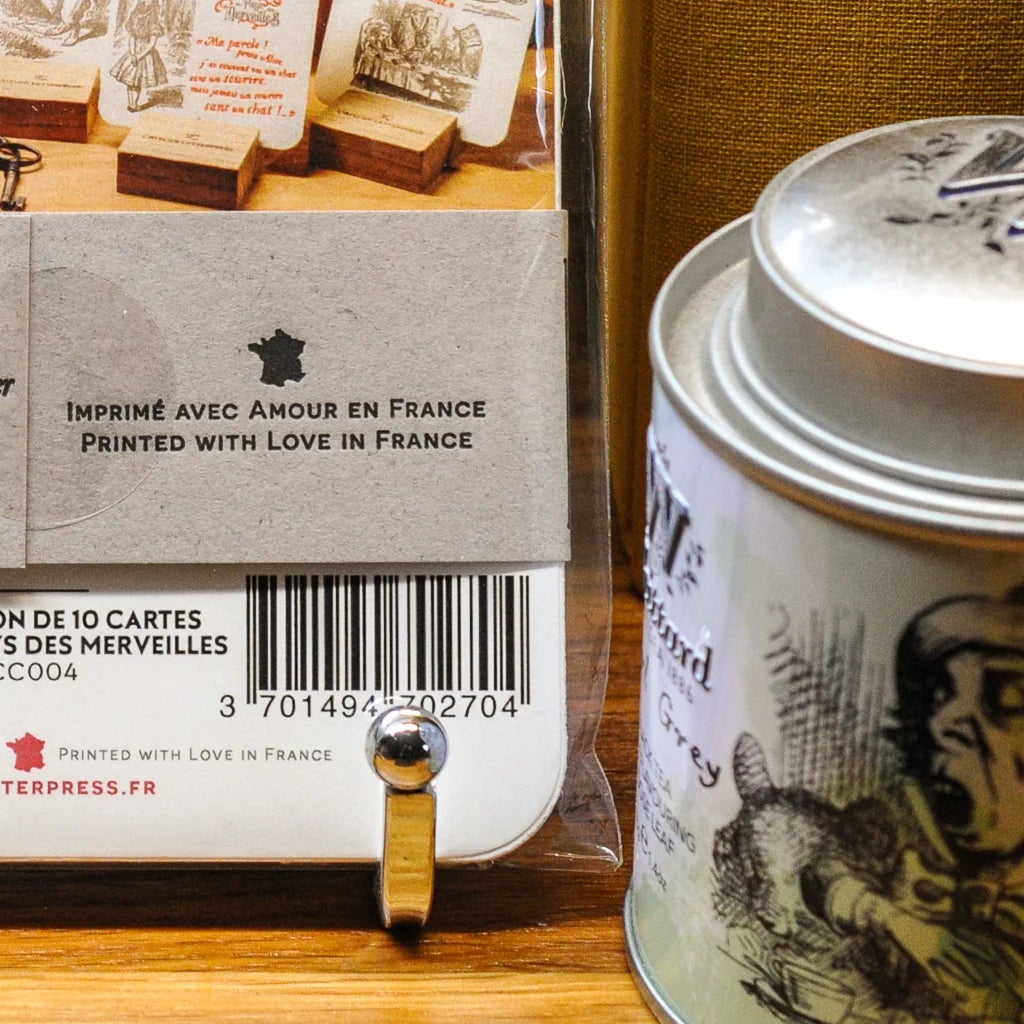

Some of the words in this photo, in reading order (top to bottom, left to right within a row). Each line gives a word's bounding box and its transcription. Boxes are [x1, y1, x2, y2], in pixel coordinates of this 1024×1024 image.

[67, 398, 166, 422] IMPRIMÉ
[175, 402, 239, 420] AVEC
[248, 400, 337, 420] AMOUR
[349, 401, 378, 419] EN
[389, 398, 486, 418] FRANCE
[81, 432, 186, 453] PRINTED
[196, 432, 256, 451] WITH
[267, 430, 331, 450] LOVE
[341, 432, 365, 450] IN
[376, 430, 472, 450] FRANCE
[33, 609, 64, 629] DE
[72, 609, 99, 629] 10
[106, 609, 201, 629] CARTES
[25, 635, 72, 654] DES
[80, 634, 228, 655] MERVEILLES
[219, 694, 236, 718] 3
[260, 694, 379, 718] 701494
[659, 693, 722, 788] Grey
[58, 747, 130, 761] PRINTED
[139, 748, 181, 761] WITH
[189, 747, 233, 761] LOVE
[242, 748, 257, 761] IN
[265, 747, 332, 761] FRANCE
